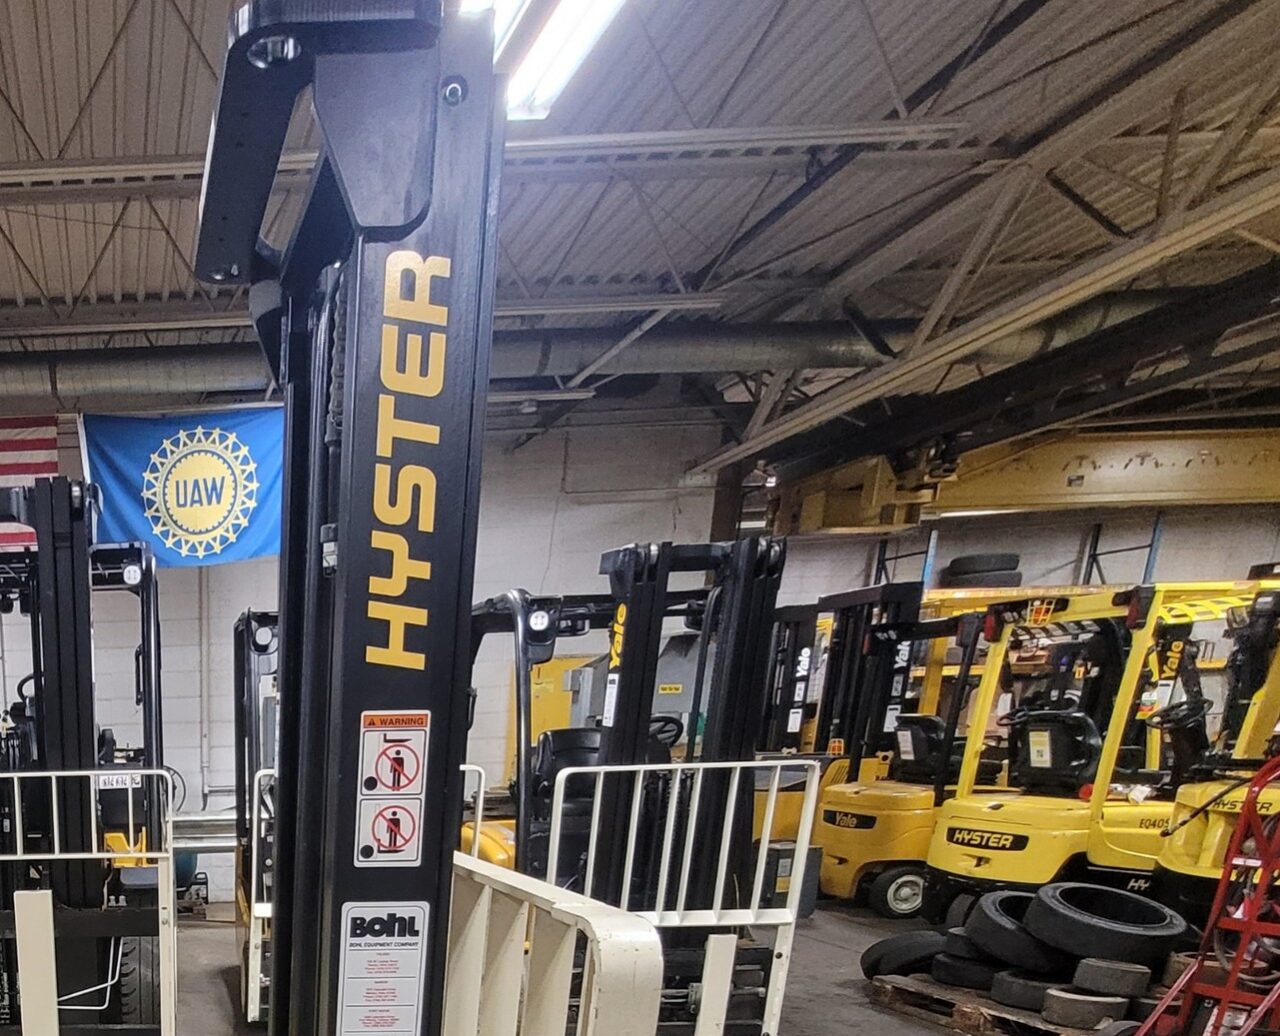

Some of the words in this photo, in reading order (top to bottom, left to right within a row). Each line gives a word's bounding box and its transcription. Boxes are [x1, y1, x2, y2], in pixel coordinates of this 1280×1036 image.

[365, 249, 451, 670] HYSTER
[176, 476, 225, 508] UAW
[609, 603, 627, 670] Yale
[795, 647, 811, 677] Yale
[1161, 640, 1184, 679] Yale
[380, 717, 424, 726] WARNING
[835, 813, 857, 828] Yale
[953, 829, 1014, 848] HYSTER
